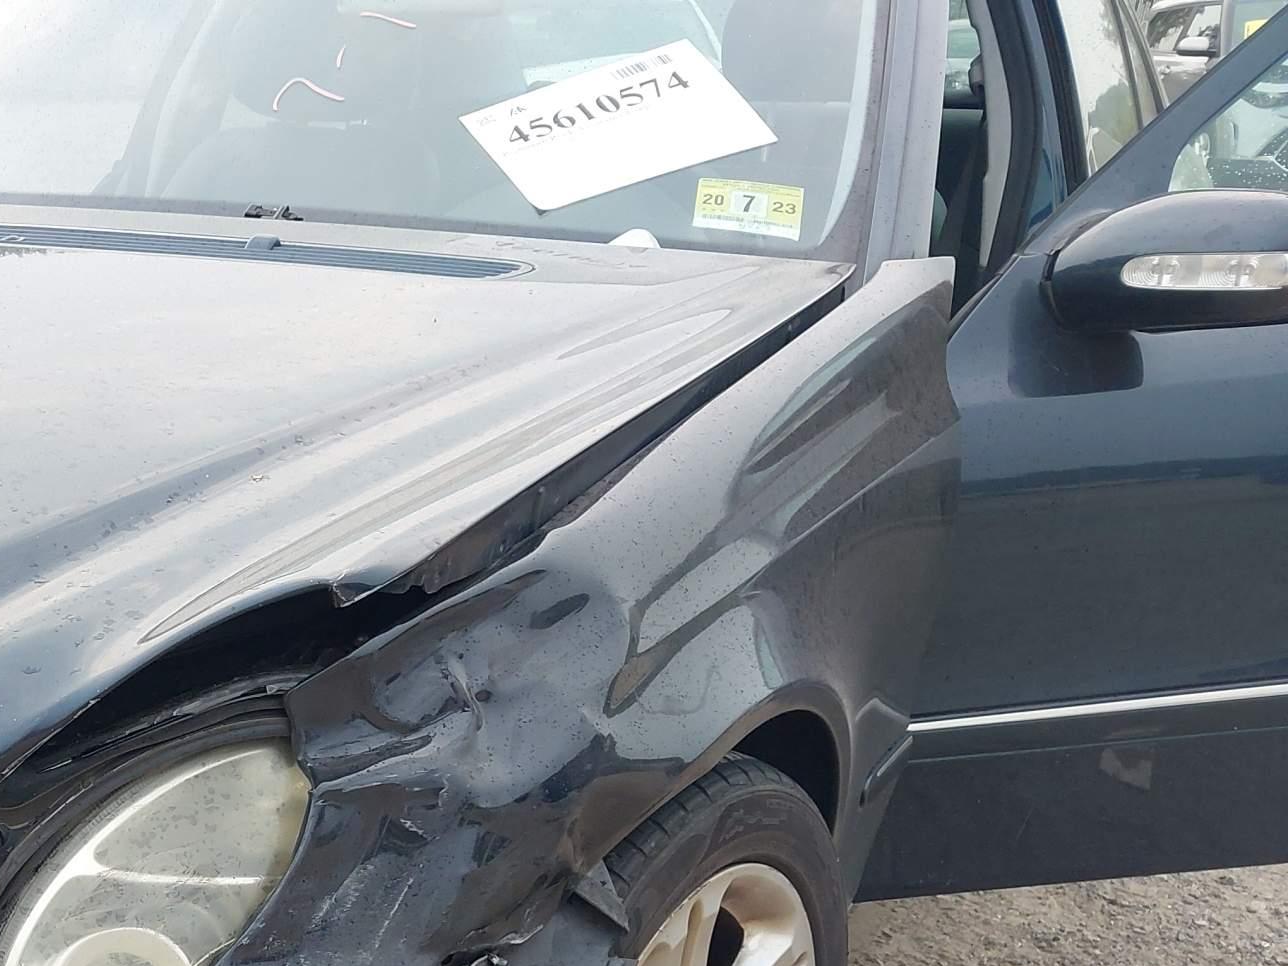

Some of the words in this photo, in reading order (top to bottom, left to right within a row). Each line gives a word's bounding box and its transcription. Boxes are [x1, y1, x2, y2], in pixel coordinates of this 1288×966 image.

[509, 71, 690, 142] 45610574
[702, 193, 725, 206] 20
[742, 194, 756, 213] 7
[772, 201, 797, 215] 23
